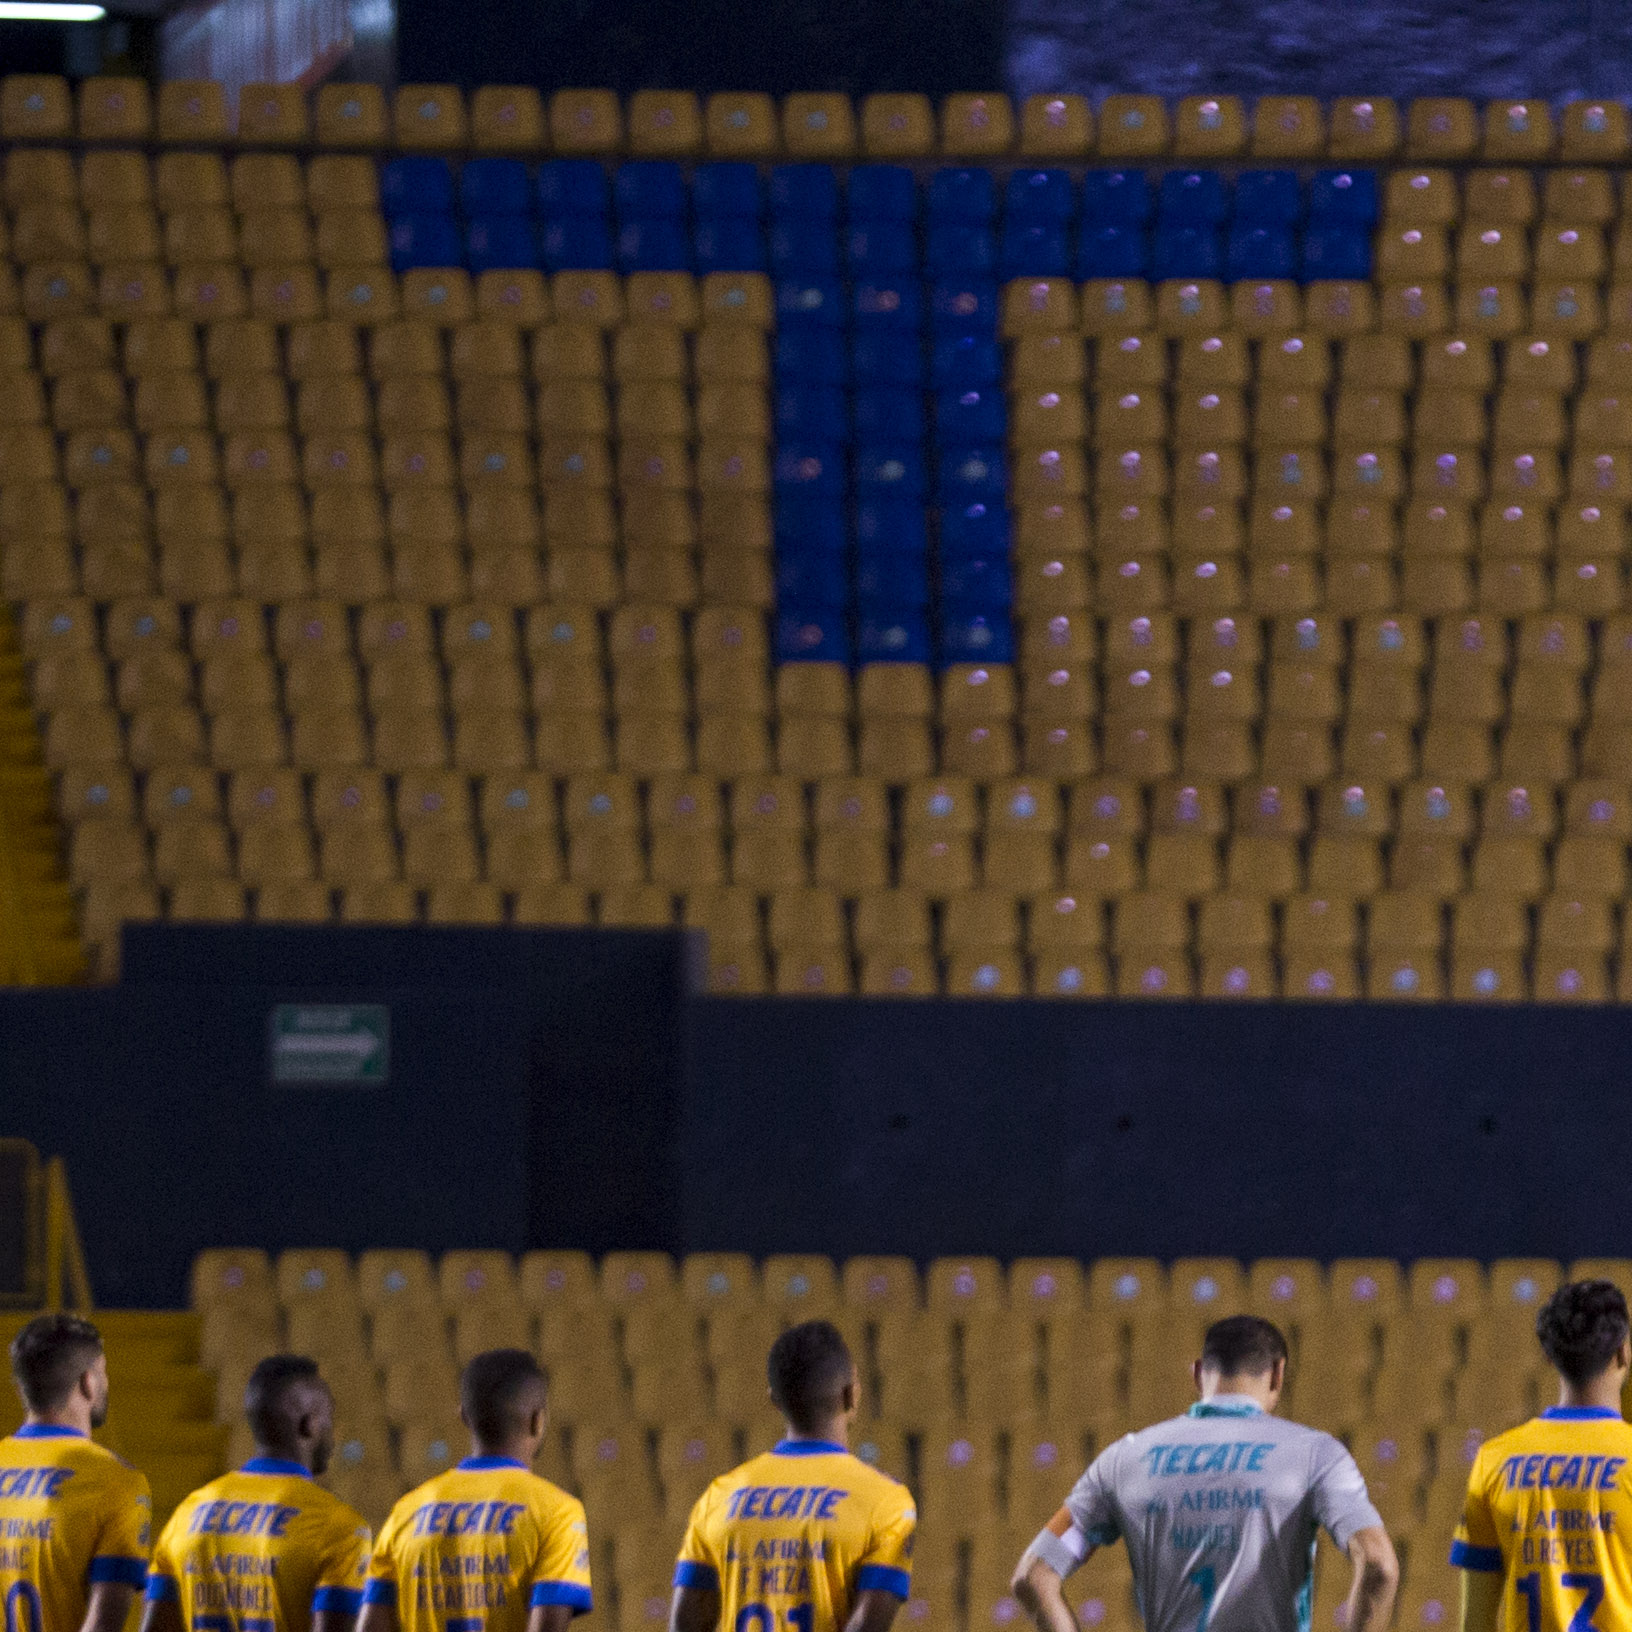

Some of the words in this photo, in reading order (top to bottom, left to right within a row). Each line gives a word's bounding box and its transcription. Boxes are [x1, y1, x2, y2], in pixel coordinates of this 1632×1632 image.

[1145, 1441, 1276, 1477] TECATE
[1502, 1455, 1627, 1491] TECATE
[0, 1467, 75, 1498] CATE
[1182, 1488, 1264, 1511] AFIRME
[187, 1499, 300, 1537] TECATE
[413, 1501, 527, 1537] TECATE
[726, 1486, 849, 1521] TECATE
[1535, 1509, 1616, 1533] AFIRME
